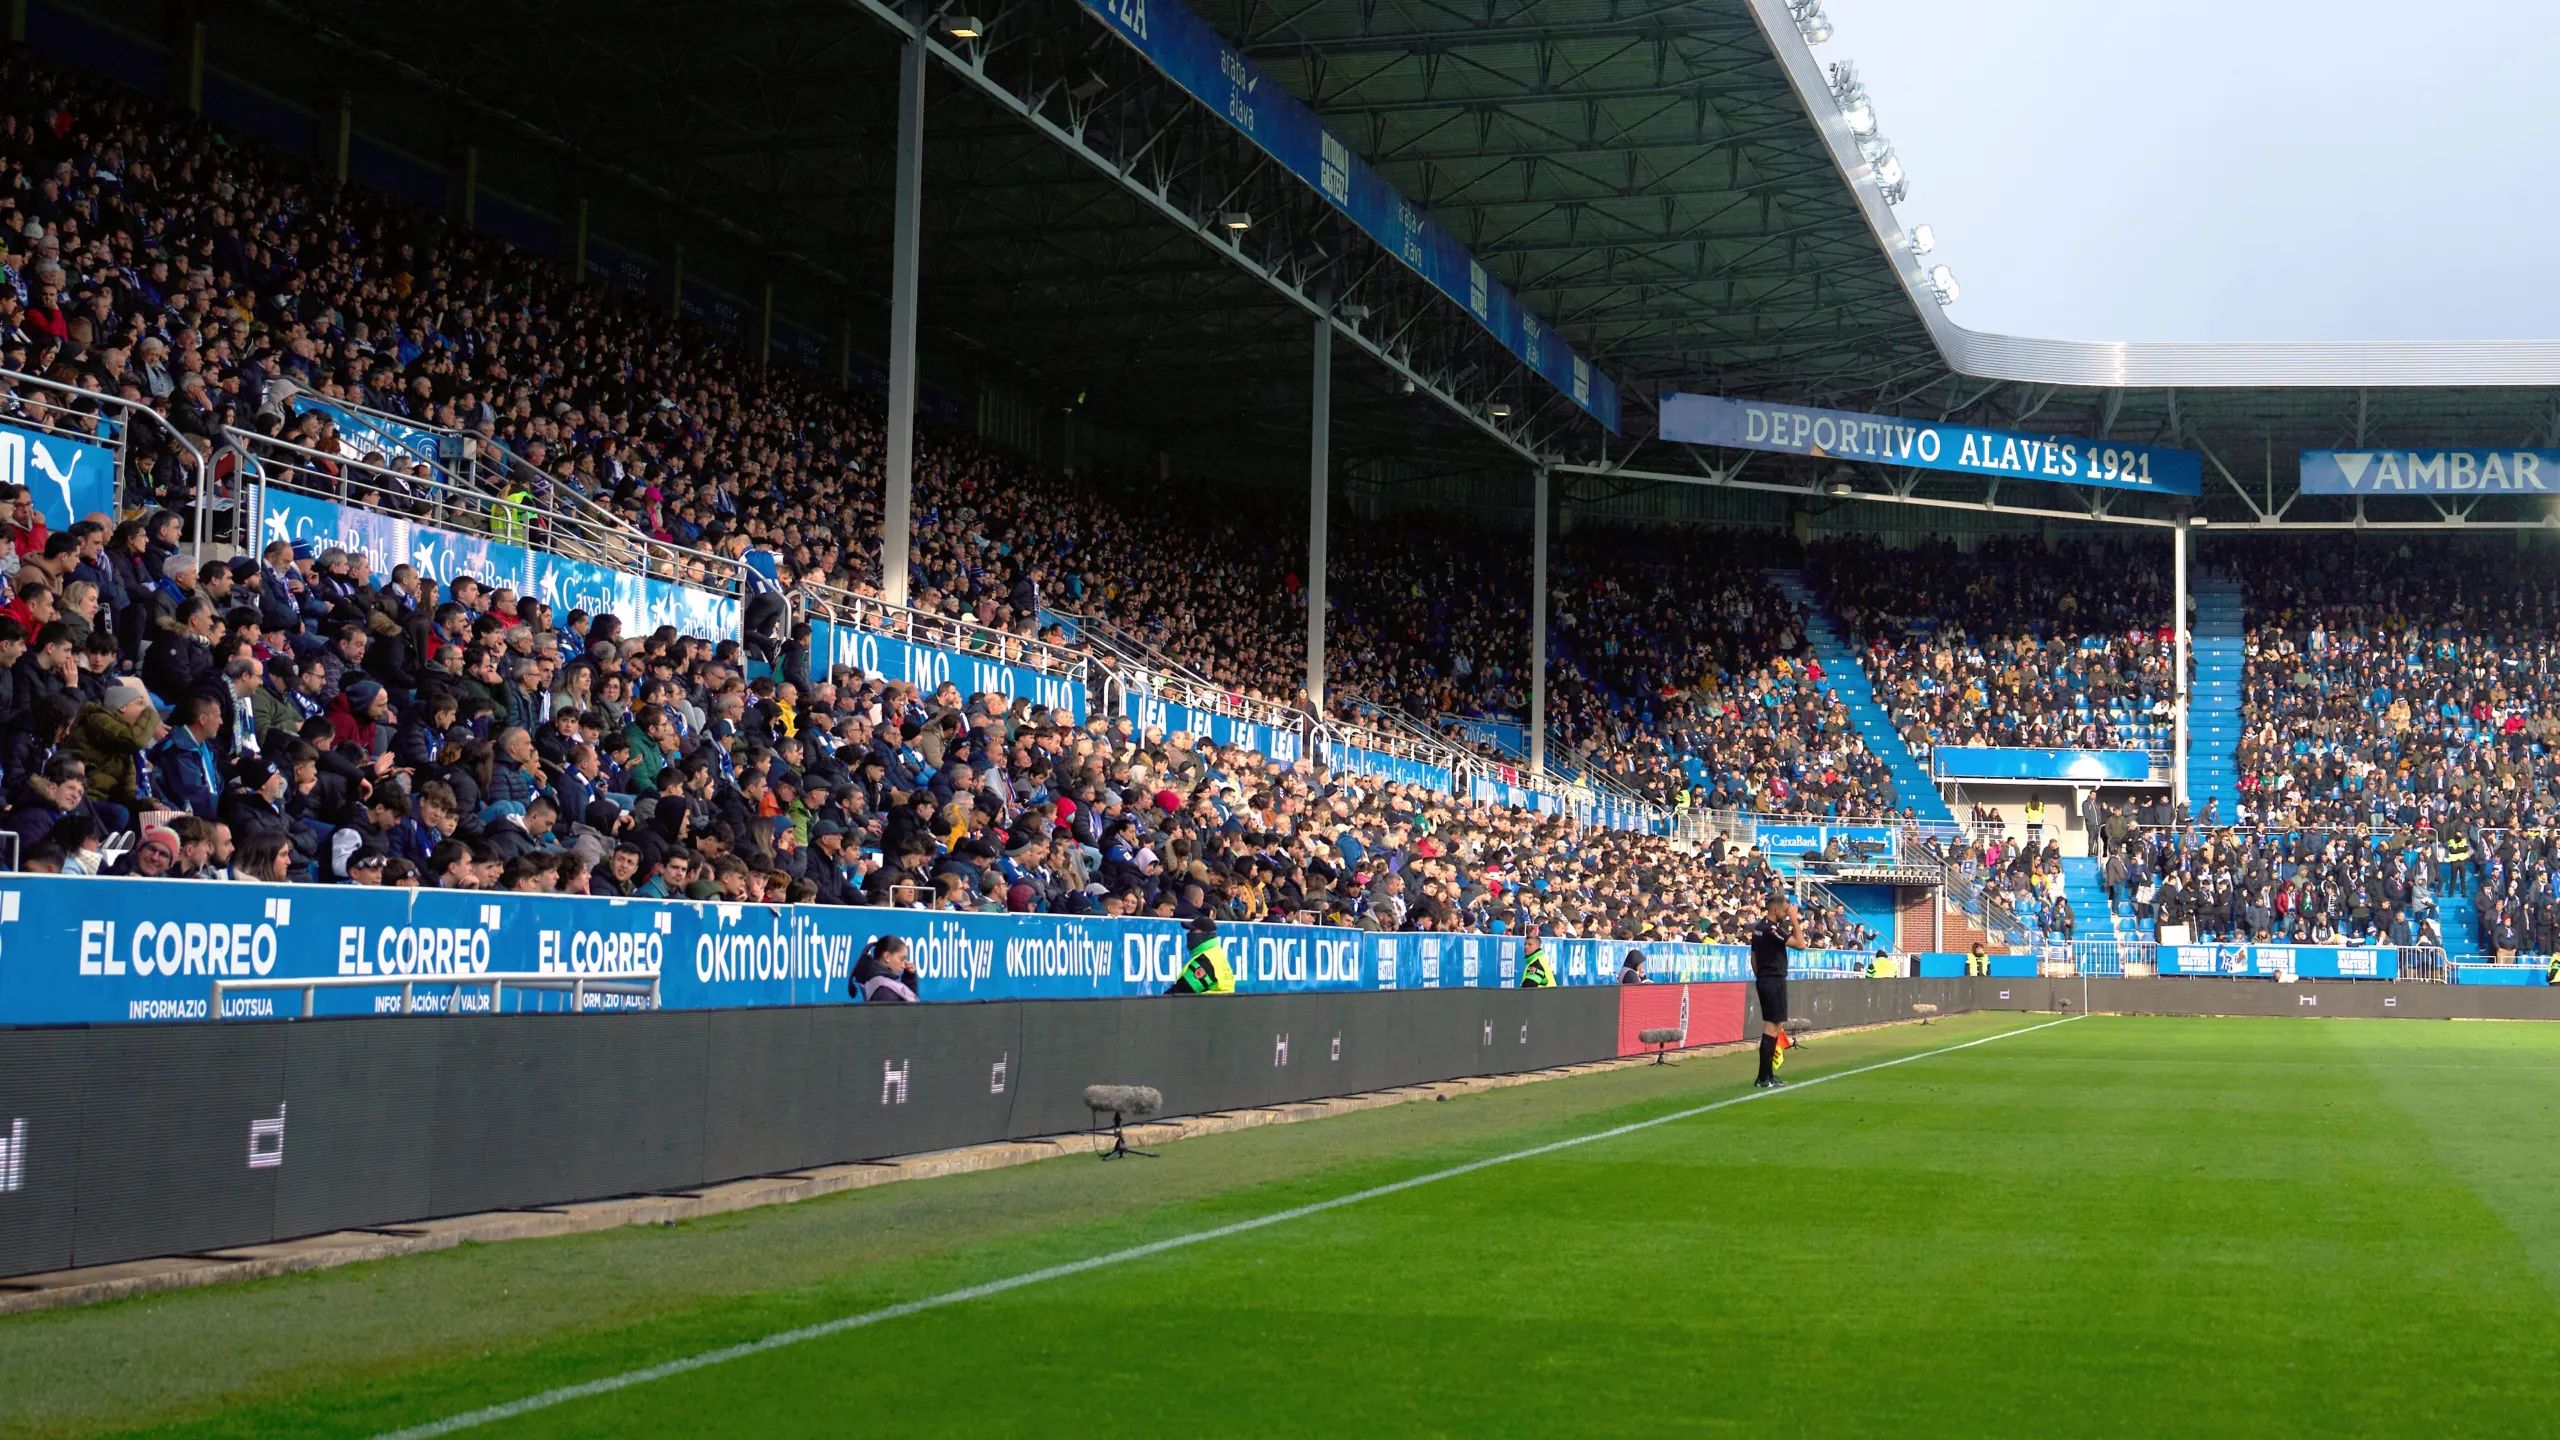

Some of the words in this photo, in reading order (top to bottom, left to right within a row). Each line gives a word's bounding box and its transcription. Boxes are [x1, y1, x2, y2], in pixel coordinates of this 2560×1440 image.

[1221, 50, 1246, 90] araba
[1230, 85, 1254, 132] álava
[1745, 408, 1941, 462] DEPORTIVO
[1959, 433, 2078, 477] ALAVÉS
[2087, 447, 2152, 484] 1921
[2372, 453, 2547, 490] AMBAR
[839, 630, 878, 673] MO
[904, 645, 950, 692] IMO
[1230, 720, 1255, 752] LEA
[1271, 730, 1294, 762] LEA
[1772, 834, 1818, 847] CaixaBank
[79, 920, 126, 976] EL
[132, 920, 277, 976] CORREO
[338, 926, 373, 975] EL
[377, 926, 490, 975] CORREO
[538, 930, 568, 972] EL
[571, 930, 663, 972] CORREO
[868, 921, 983, 992] mobility
[1124, 933, 1182, 982] DIGI
[1218, 937, 1248, 981] GI
[1258, 938, 1306, 981] DIGI
[1316, 940, 1359, 981] DIGI
[129, 999, 206, 1019] INFORMAZIO
[220, 998, 273, 1017] ALIOTSUA
[375, 991, 438, 1012] INFORACIÓN
